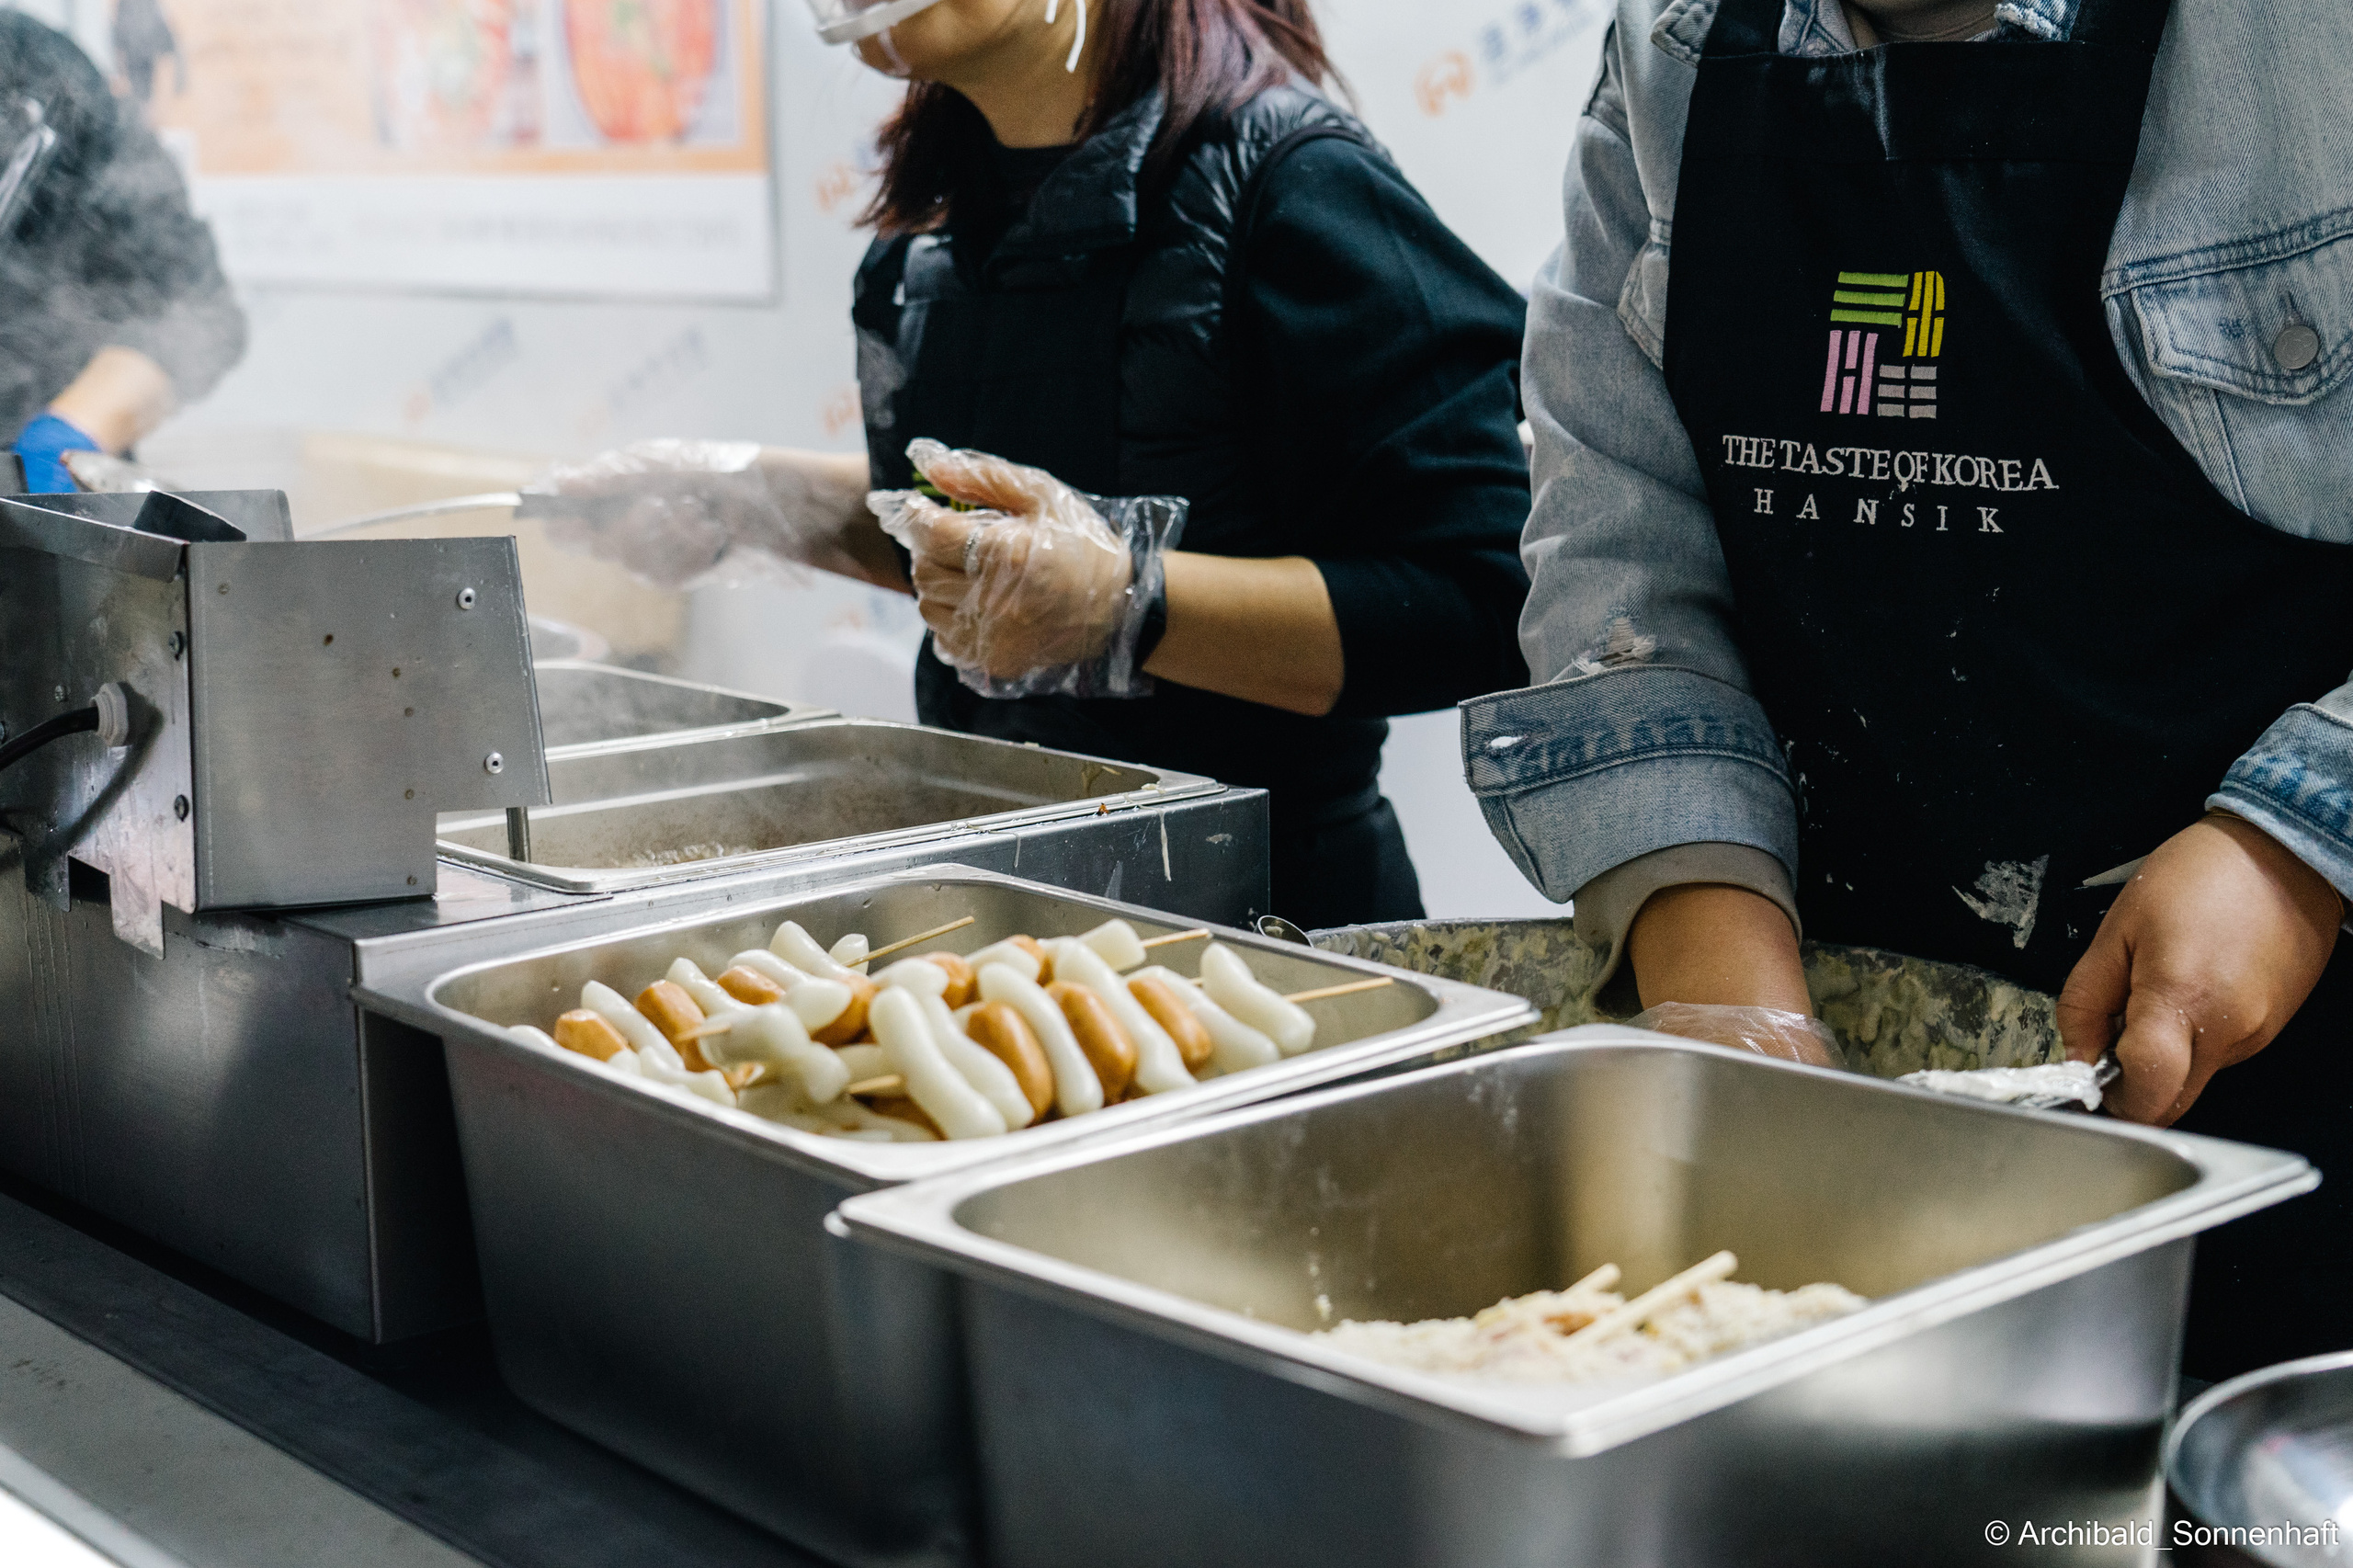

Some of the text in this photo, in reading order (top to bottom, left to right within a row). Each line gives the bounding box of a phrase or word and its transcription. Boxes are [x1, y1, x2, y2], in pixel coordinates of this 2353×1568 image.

[1722, 434, 2060, 492] THE TASTE OF KOREA
[1753, 487, 2005, 533] HANSIK
